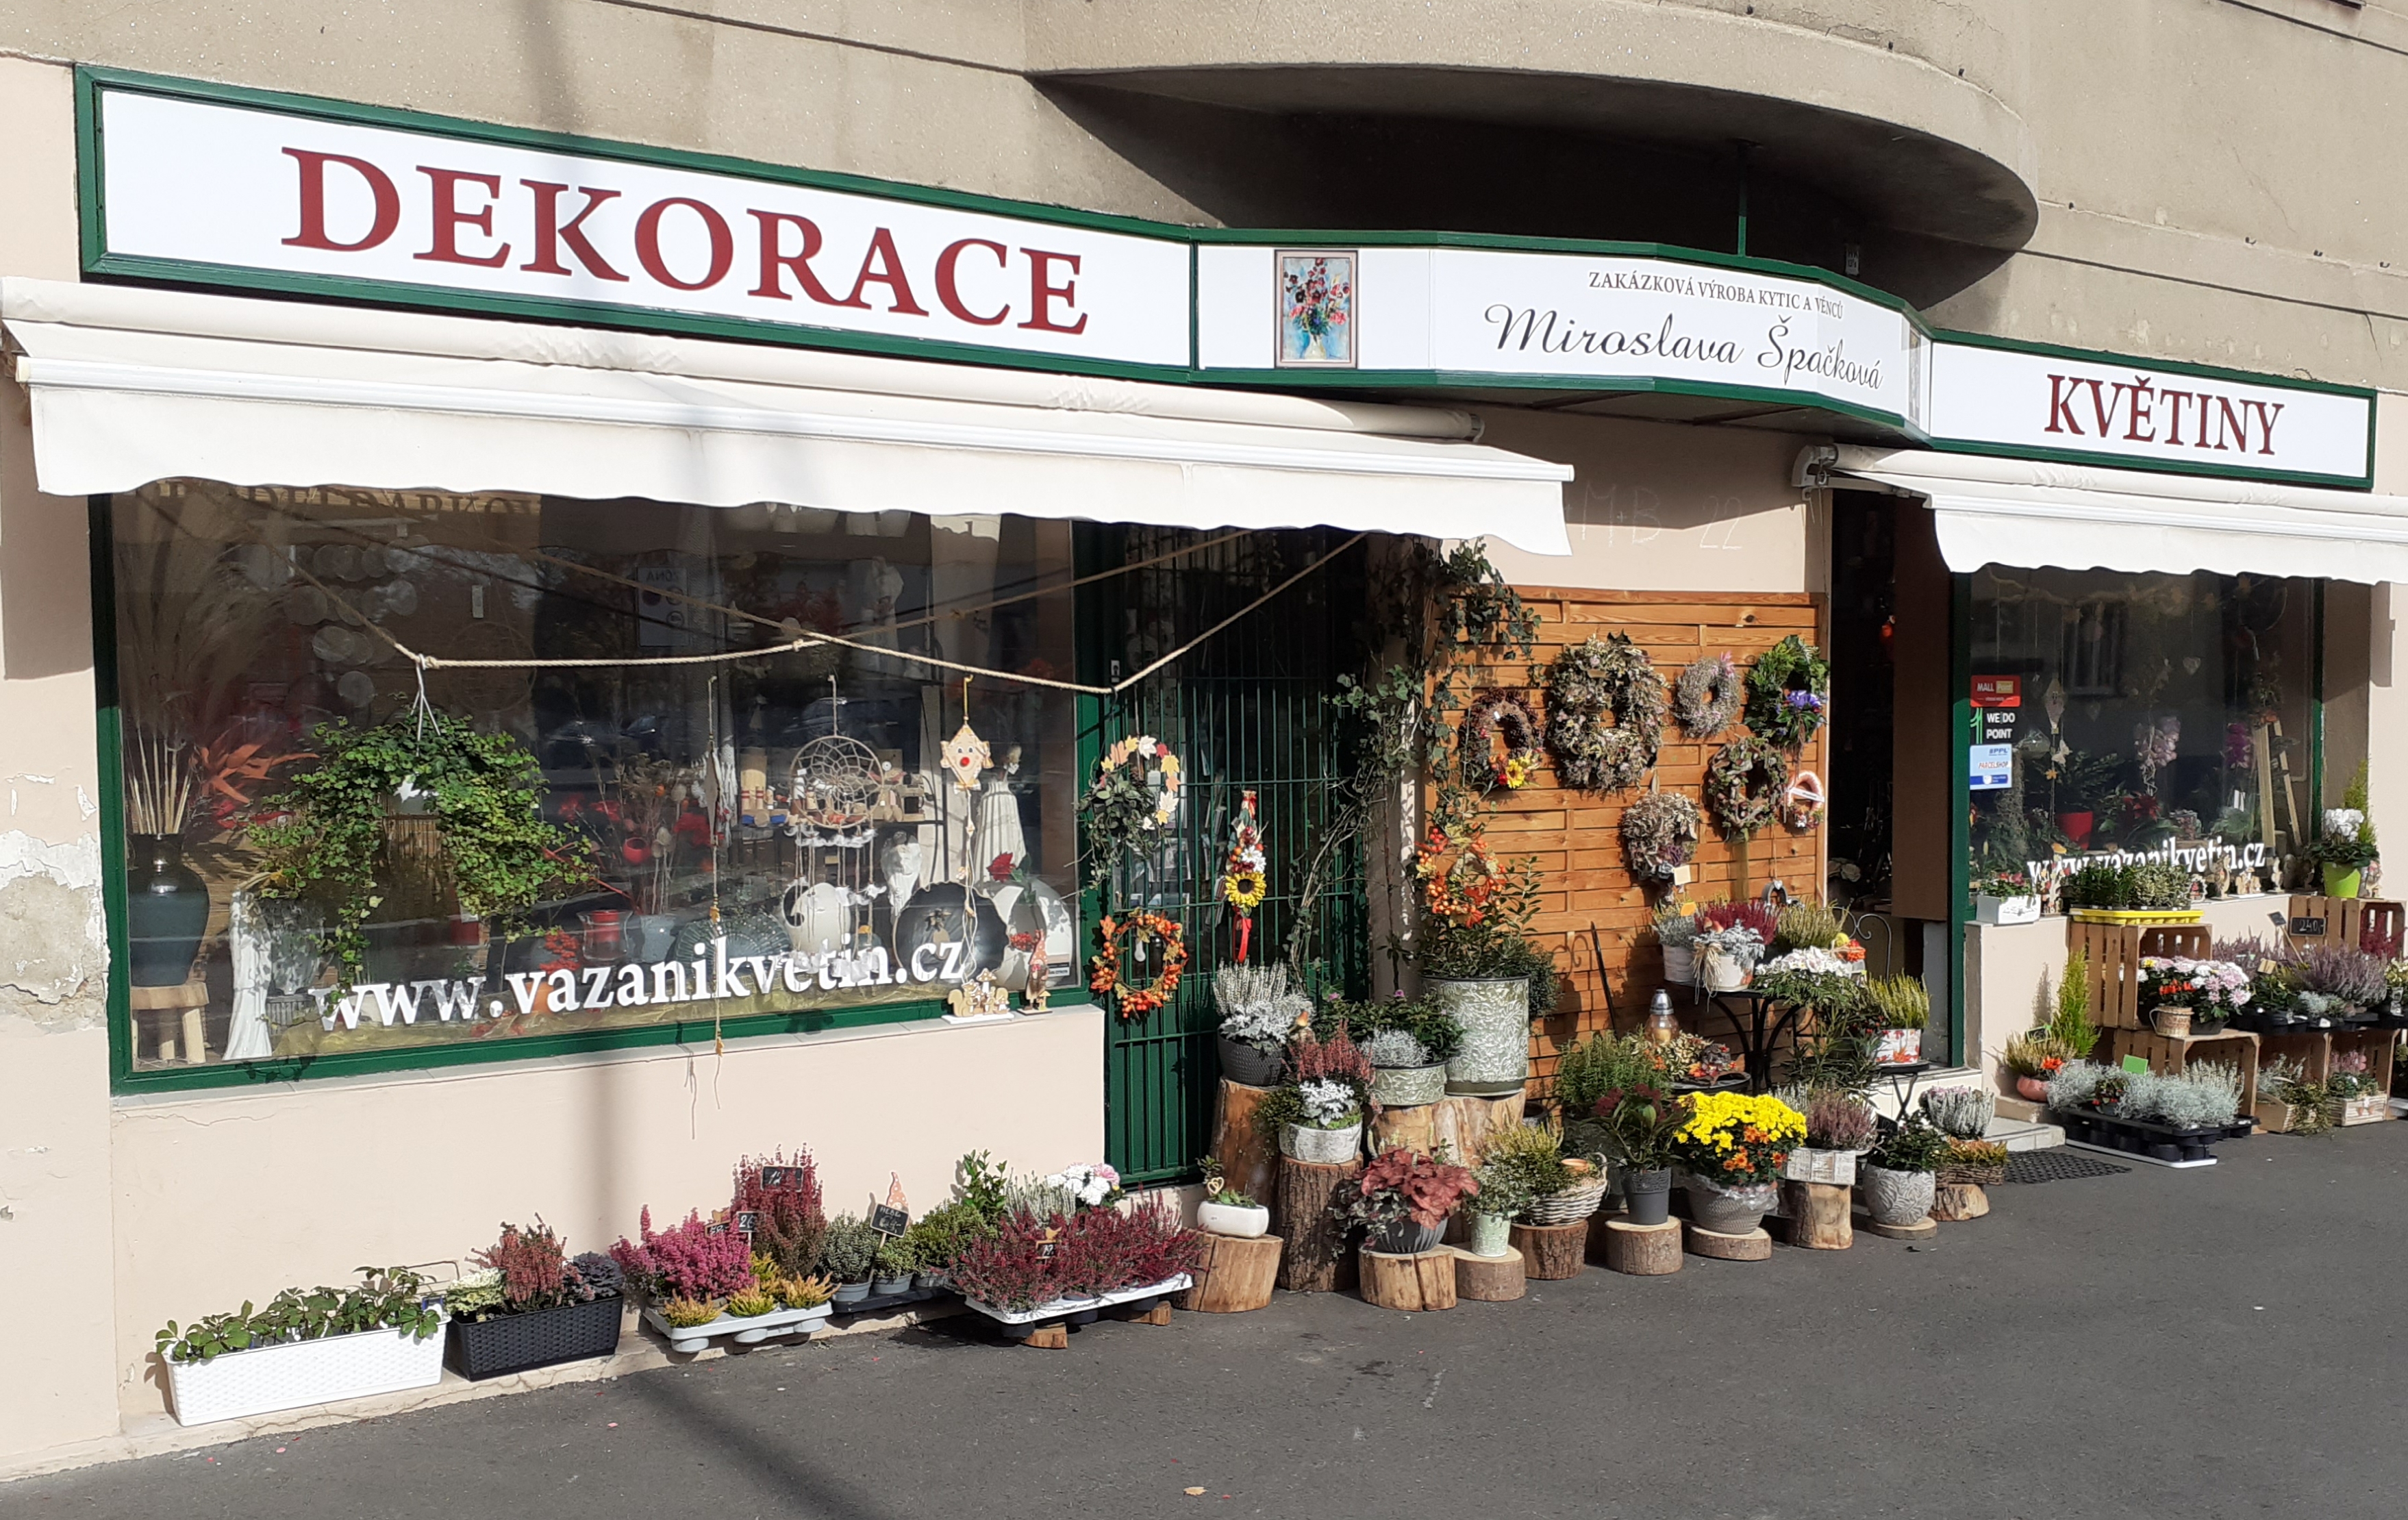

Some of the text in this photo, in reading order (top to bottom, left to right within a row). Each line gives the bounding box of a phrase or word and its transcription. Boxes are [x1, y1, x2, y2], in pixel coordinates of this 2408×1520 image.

[281, 147, 1088, 335] DEKORACE
[1589, 271, 1695, 296] ZAKÁZKOVÁ
[1698, 279, 1756, 303] VÝROBA
[1758, 289, 1801, 310] KYTIC
[1803, 296, 1812, 311] A
[1485, 303, 1885, 391] Miroslava Špačková
[2044, 375, 2285, 455] KVĚTINY
[1977, 683, 1994, 692] MALL
[1986, 729, 2012, 739] POINT
